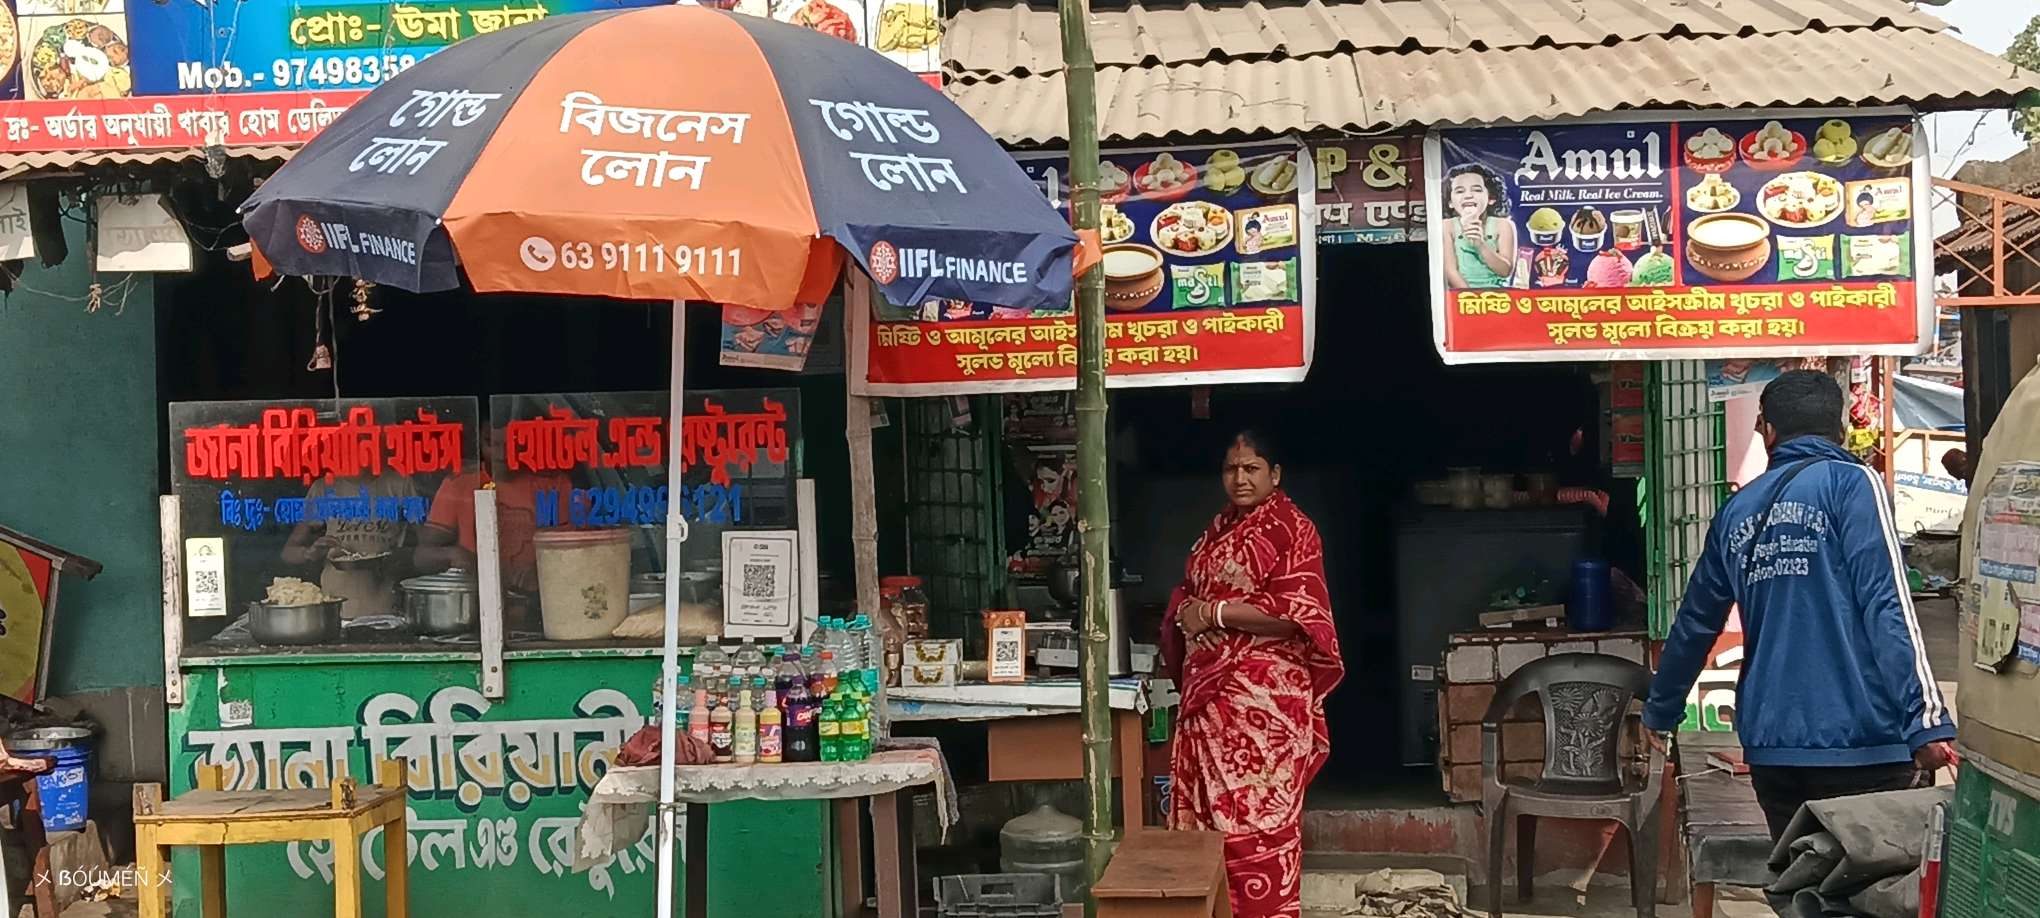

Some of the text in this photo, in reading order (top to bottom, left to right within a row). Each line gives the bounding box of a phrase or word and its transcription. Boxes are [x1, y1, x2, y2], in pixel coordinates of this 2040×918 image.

[393, 5, 461, 40] উমা
[177, 60, 264, 91] Mob.-
[44, 107, 97, 141] অর্ডার
[103, 103, 172, 146] অনুযায়ী
[239, 107, 280, 137] হোম
[389, 89, 502, 129] গোল্ড
[559, 90, 752, 144] বিজনেস
[809, 98, 941, 144] গোল্ড
[349, 135, 448, 175] লোন
[580, 148, 712, 190] লোন
[848, 152, 968, 194] লোন
[1362, 144, 1407, 188] &
[1514, 130, 1664, 187] Amul
[1520, 189, 1546, 202] Real
[1578, 188, 1602, 201] Real
[1604, 188, 1621, 200] Ice
[1623, 187, 1664, 200] Cream.
[359, 232, 416, 266] FINANCE
[561, 241, 741, 277] 63 9111 9111
[899, 247, 1028, 285] IIFL FINANCE
[1458, 282, 1897, 321] মিষ্টি ও আমূলের আইসক্রীম খুচরা ও পাইকারী
[926, 328, 942, 346] ও
[945, 324, 1027, 351] আমূলের
[1128, 319, 1177, 344] খুচরা
[1182, 318, 1199, 336] ও
[1202, 307, 1285, 335] পাইকারী
[1548, 318, 1599, 346] সুলভ
[1655, 313, 1714, 340] বিক্রয়
[1719, 316, 1764, 339] করা
[957, 348, 1004, 377] সুলভ
[1117, 346, 1160, 366] করা
[184, 405, 463, 487] জানা বিরিয়ানি হাউস
[506, 403, 599, 472] হোটেল
